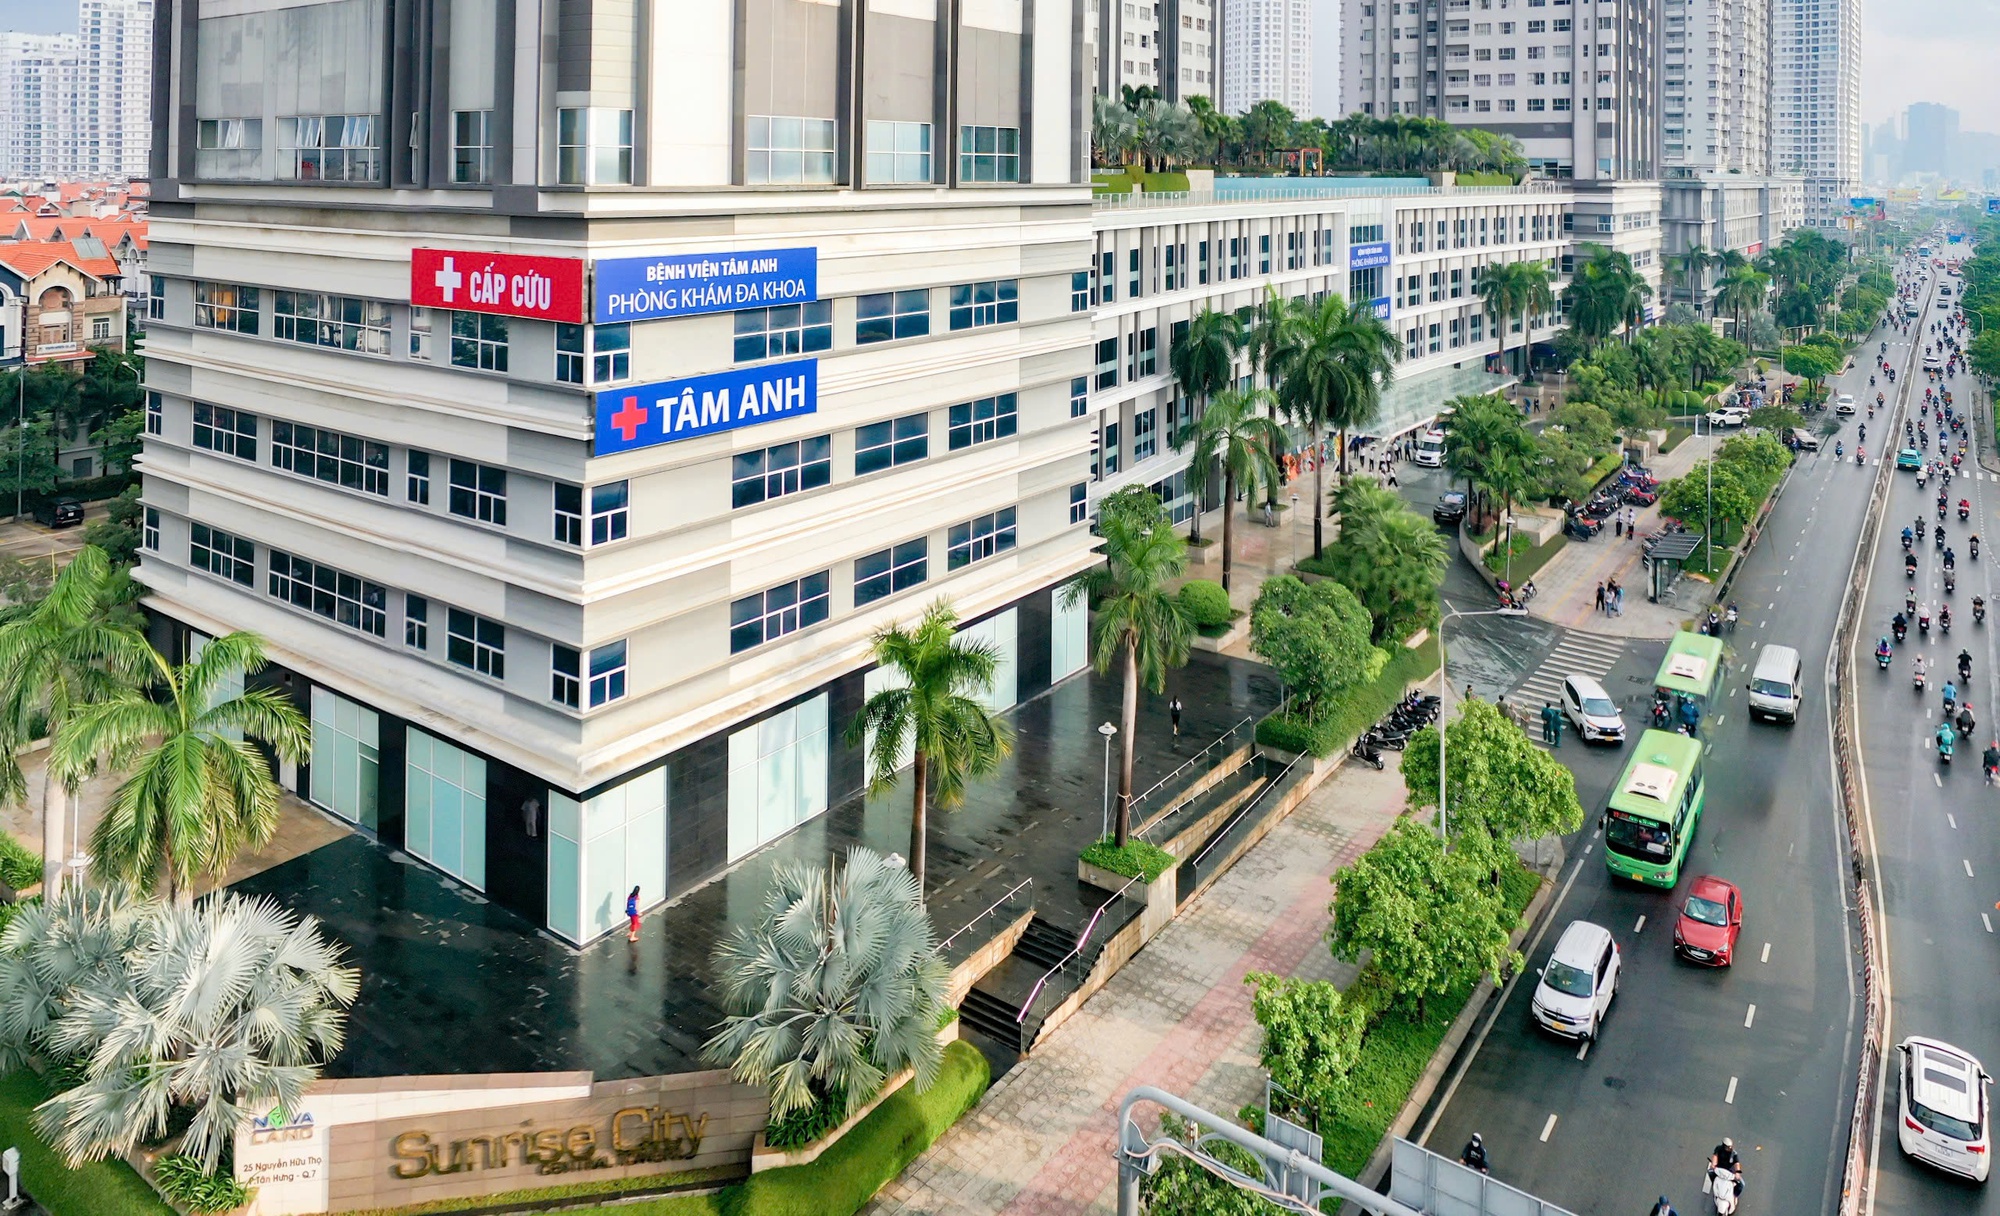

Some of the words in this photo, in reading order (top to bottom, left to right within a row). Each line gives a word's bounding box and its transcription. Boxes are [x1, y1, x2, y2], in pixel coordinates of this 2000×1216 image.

[647, 262, 685, 283] BỆNH
[687, 260, 720, 281] VIỆN
[721, 257, 748, 277] TÂM
[749, 258, 778, 274] ANH
[469, 261, 506, 305] CẤP
[512, 268, 552, 310] CỨU
[609, 288, 677, 315] PHÒNG
[681, 282, 733, 309] KHÁM
[735, 281, 762, 303] ĐA
[764, 279, 807, 301] KHOA
[1375, 303, 1388, 319] ANH
[656, 387, 730, 434] TÂM
[737, 375, 806, 420] ANH
[251, 1128, 313, 1145] LAND
[394, 1118, 596, 1180] Sunrise
[612, 1105, 710, 1160] City
[243, 1164, 253, 1172] 25
[255, 1158, 288, 1172] Nguyễn
[290, 1158, 306, 1167] Hữu
[308, 1156, 323, 1165] Thọ
[273, 1173, 294, 1183] Hưng
